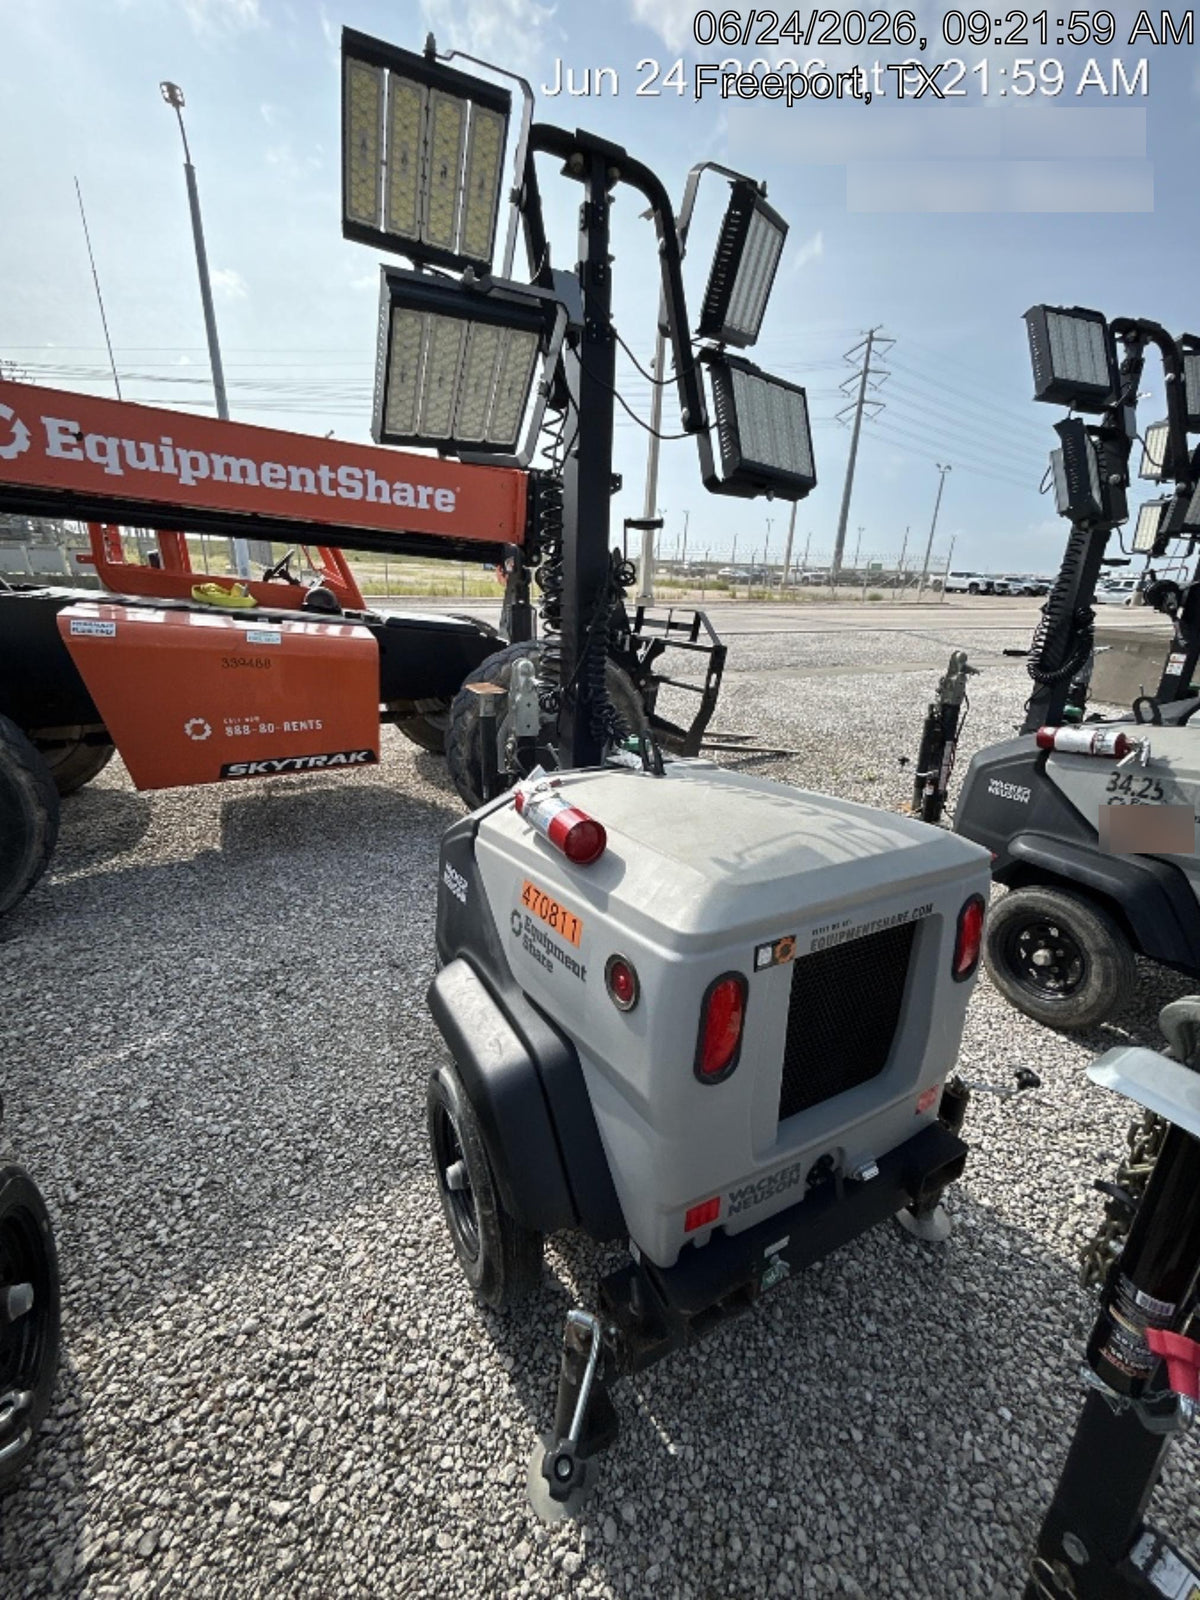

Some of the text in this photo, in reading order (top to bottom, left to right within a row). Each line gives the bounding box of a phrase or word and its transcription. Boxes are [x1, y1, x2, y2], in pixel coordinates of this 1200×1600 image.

[42, 416, 456, 513] EquipmentShare
[227, 751, 368, 776] SKYTRAK
[1106, 771, 1164, 800] 34.25
[522, 885, 577, 943] 470811
[522, 934, 554, 973] Share
[524, 915, 588, 982] Equipment
[729, 1163, 800, 1203] WACKER
[729, 1171, 800, 1217] NEUSON
